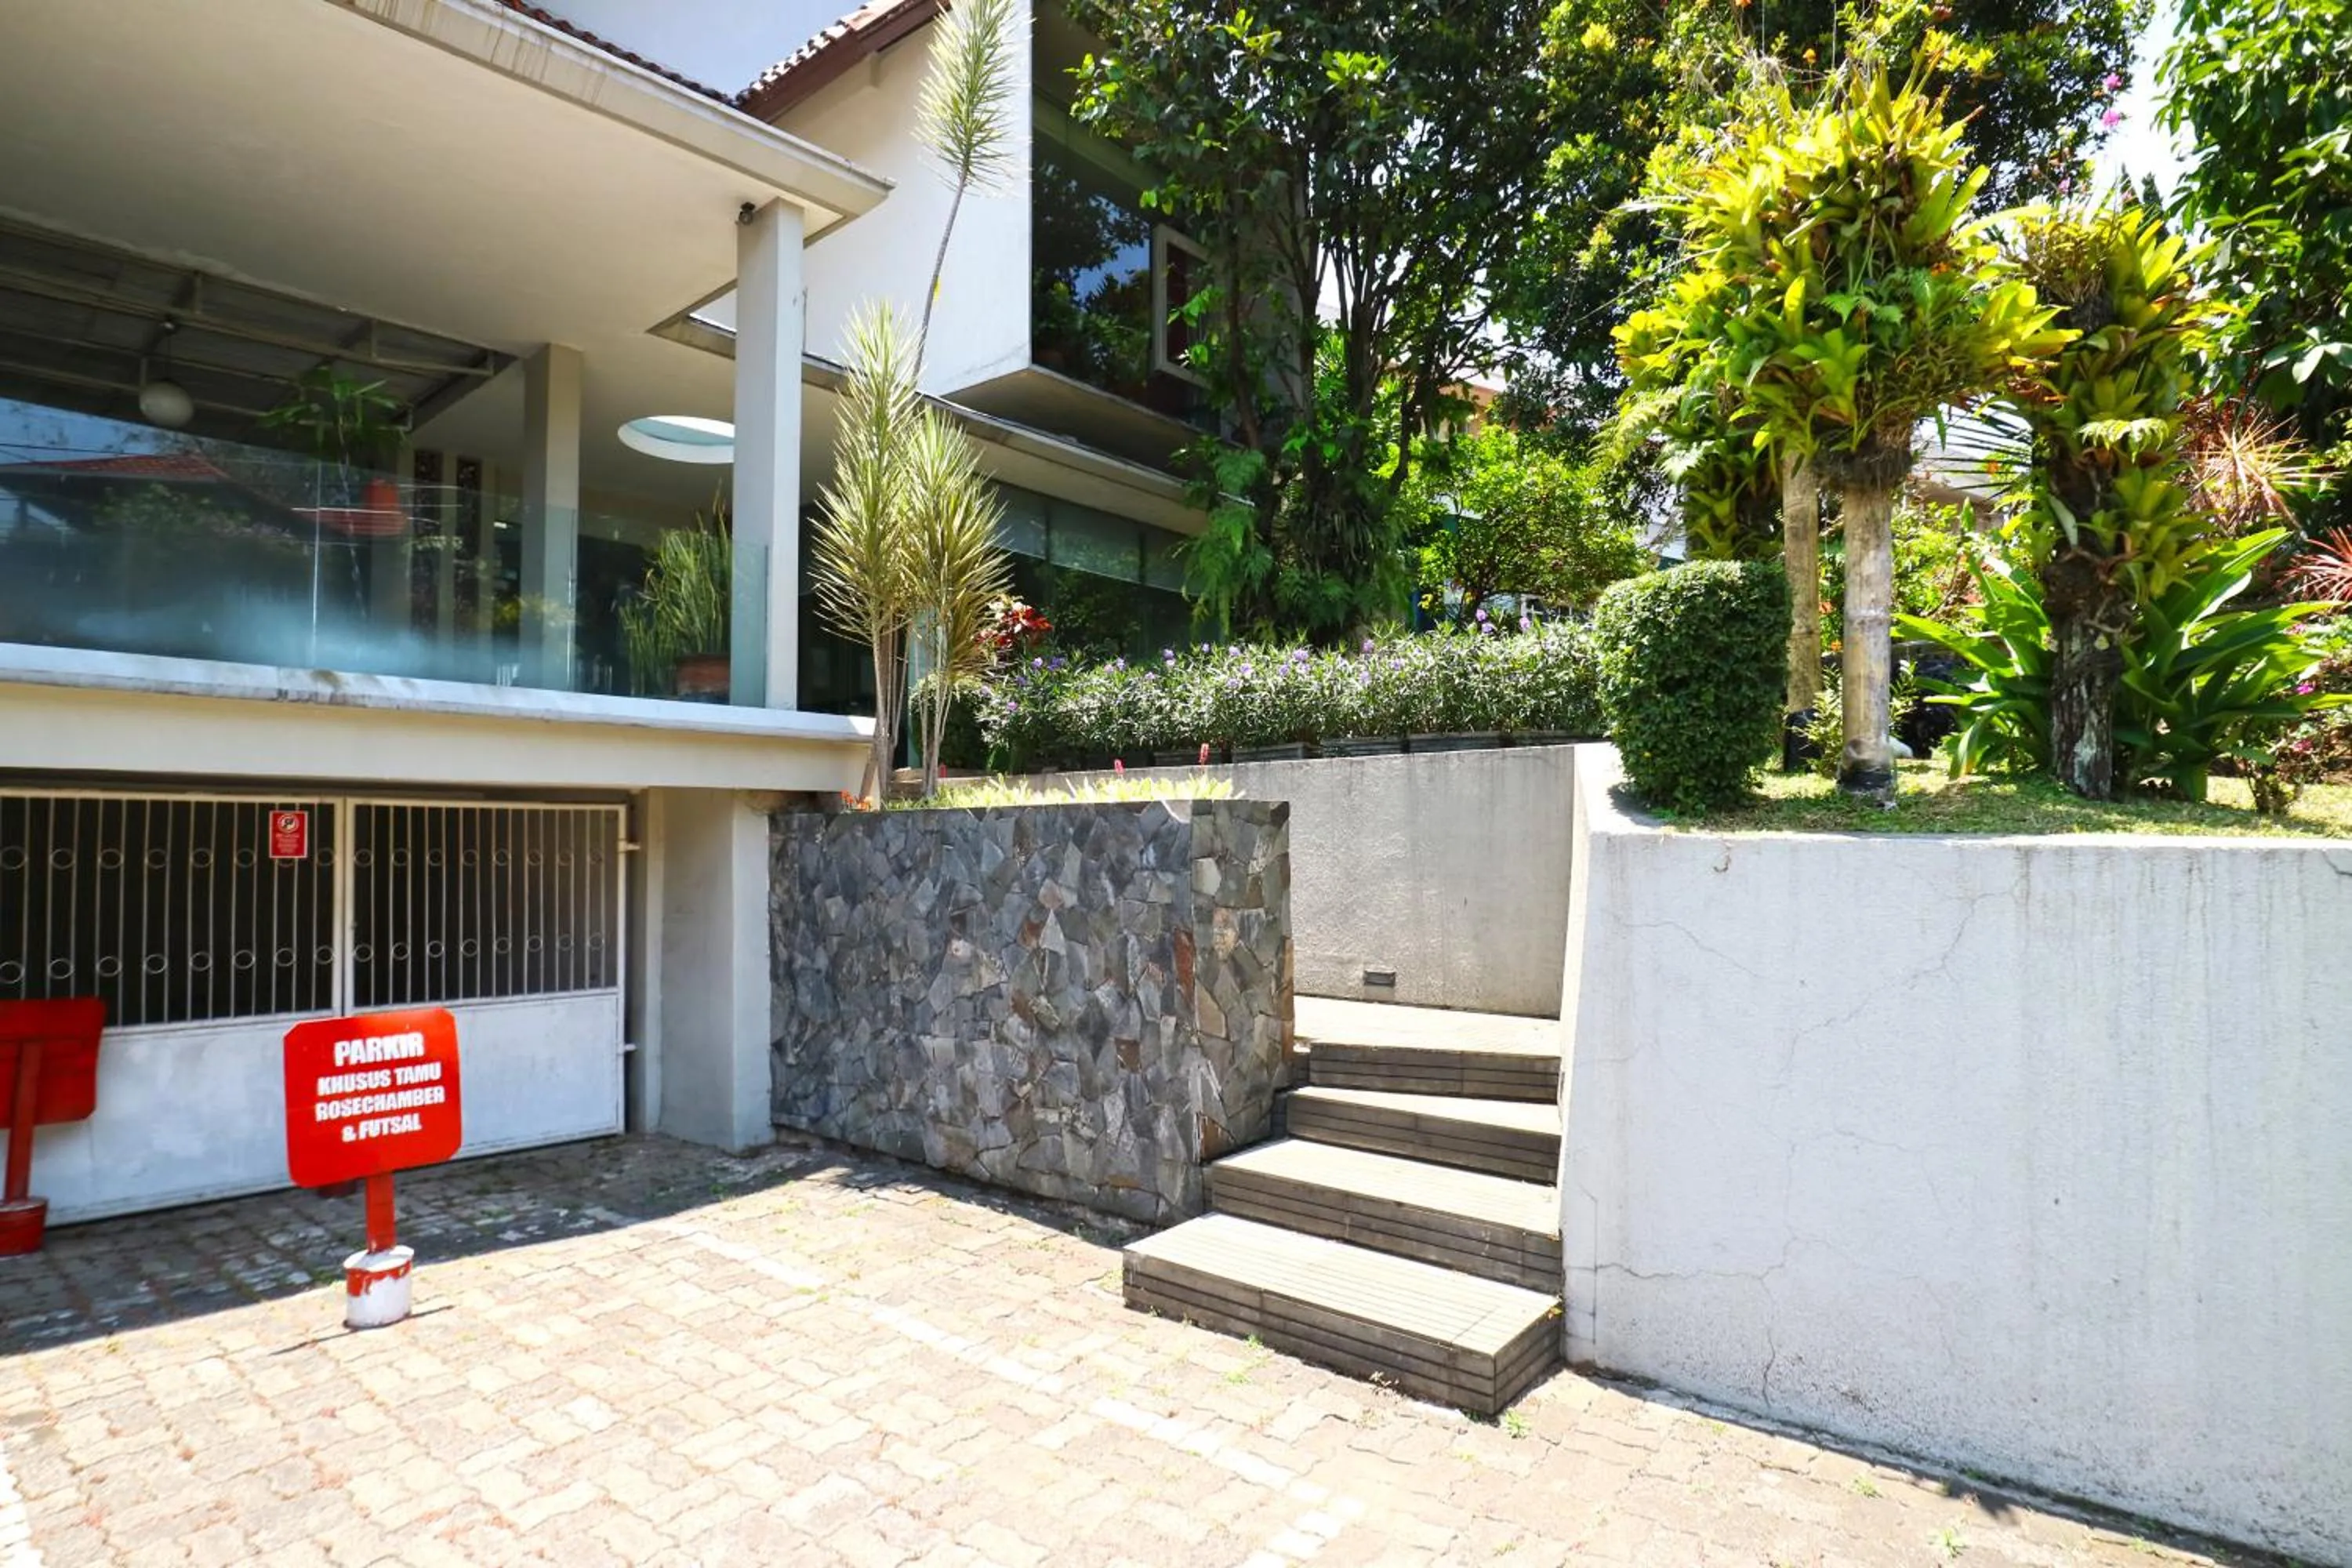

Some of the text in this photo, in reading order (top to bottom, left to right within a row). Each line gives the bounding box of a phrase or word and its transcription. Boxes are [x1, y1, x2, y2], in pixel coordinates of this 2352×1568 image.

[335, 1033, 424, 1066] PARKIR
[318, 1062, 441, 1096] KHUSUS TAMU
[315, 1086, 445, 1122] ROSECHAMBER
[342, 1113, 422, 1142] & FUTSAL
